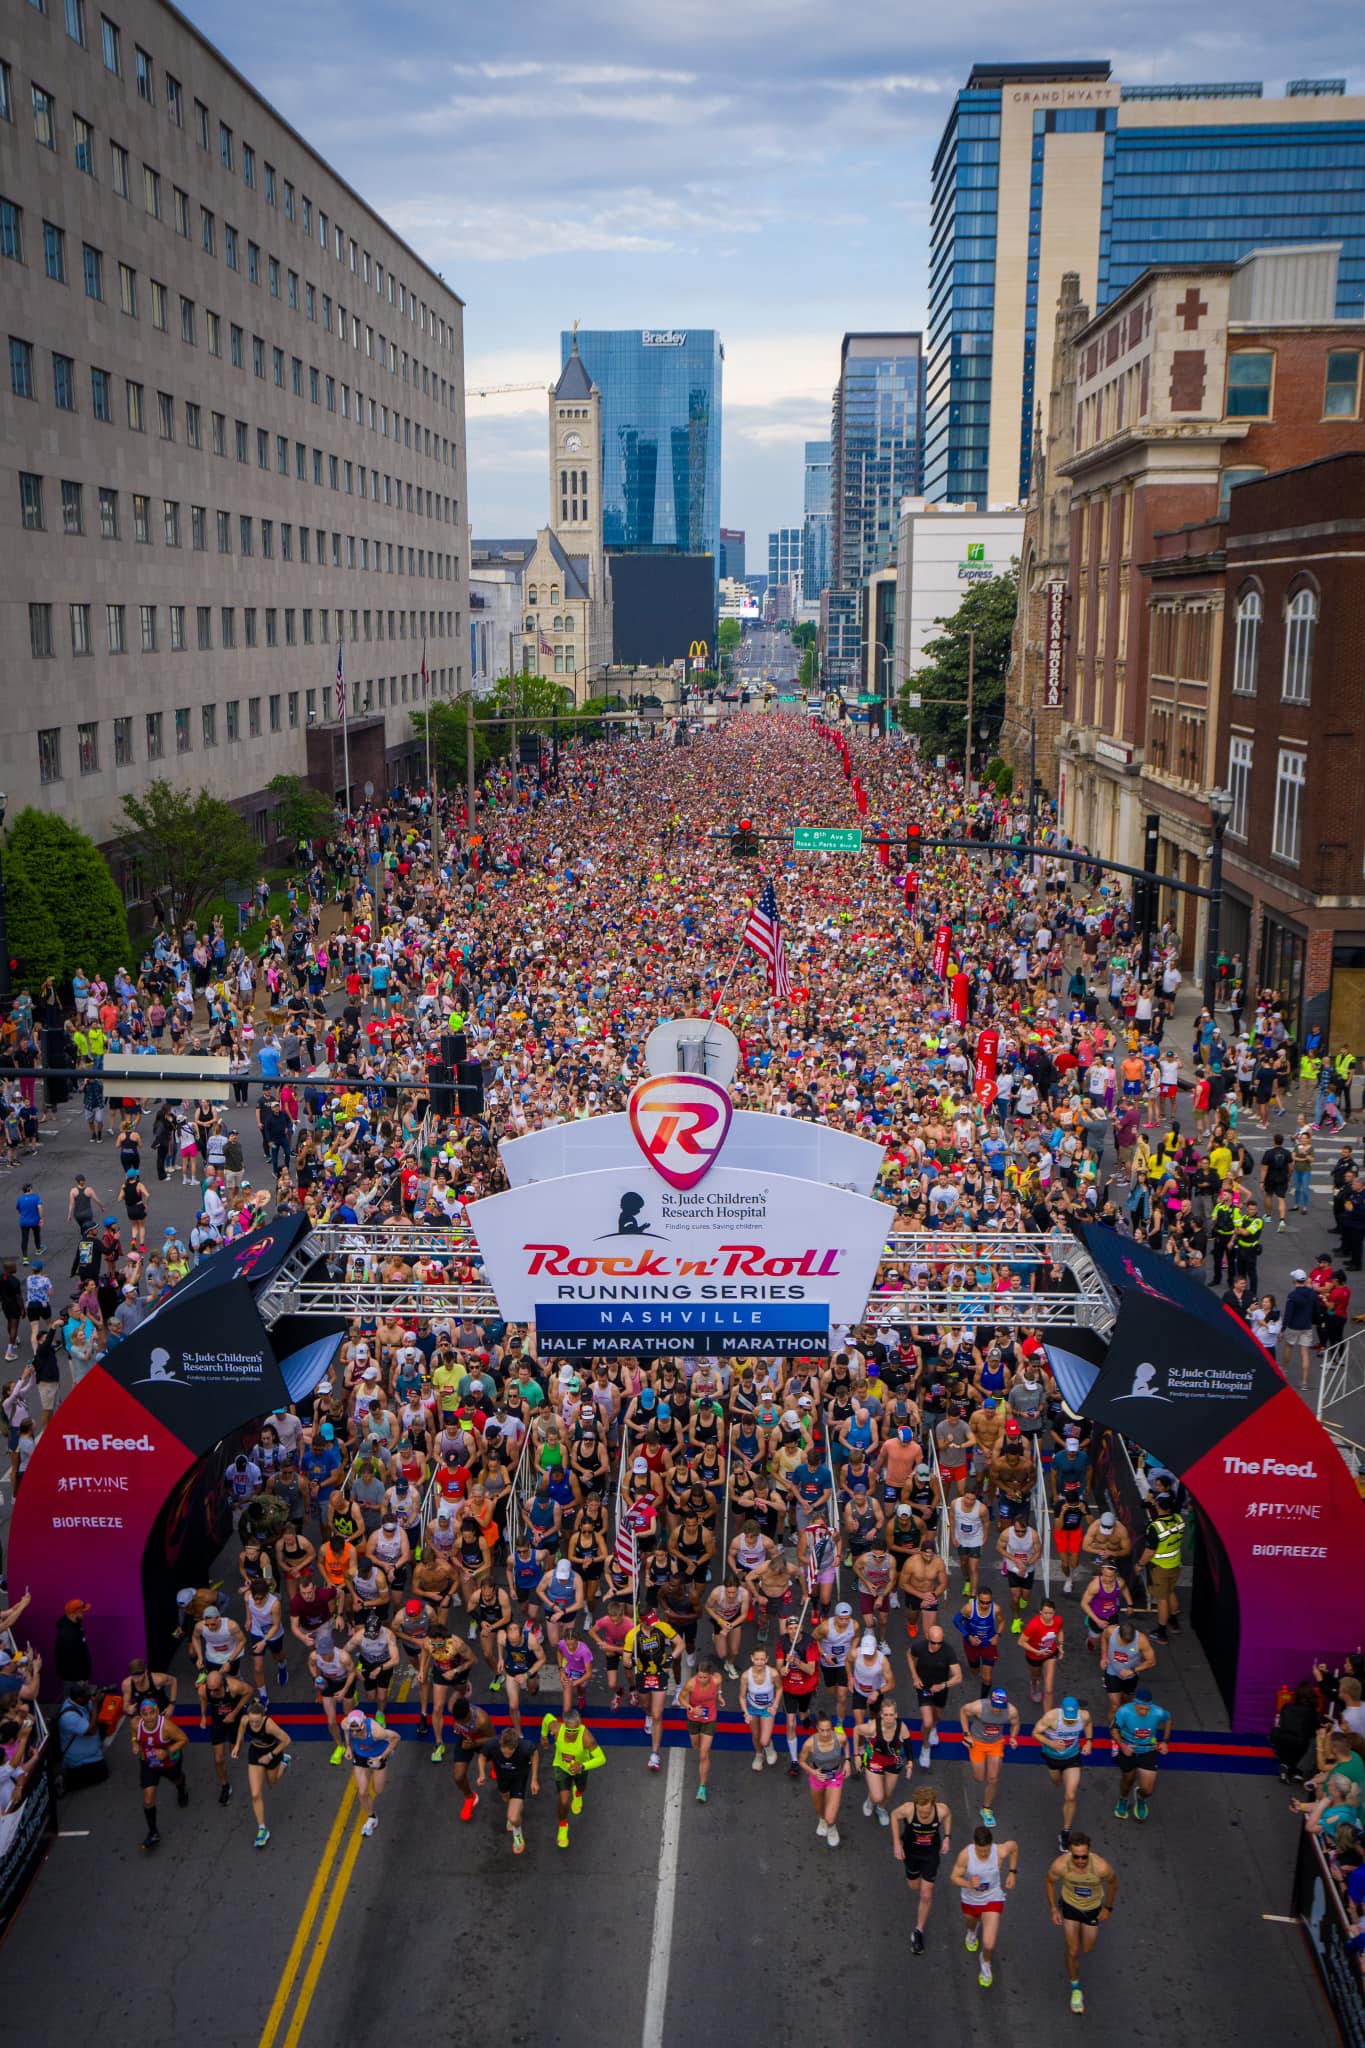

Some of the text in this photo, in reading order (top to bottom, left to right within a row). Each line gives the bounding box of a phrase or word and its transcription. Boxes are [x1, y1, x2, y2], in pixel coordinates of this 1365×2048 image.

[1013, 89, 1112, 102] GRAND HYATT
[642, 330, 687, 346] Bradley
[958, 569, 993, 580] Express
[1048, 583, 1063, 704] MORGAN & MORGAN
[813, 831, 827, 839] 8th
[983, 1044, 992, 1054] 1
[981, 1083, 992, 1096] 2
[662, 1193, 766, 1206] St. Jude Children's
[662, 1207, 766, 1220] Research Hospital
[523, 1244, 672, 1277] Rock
[718, 1245, 840, 1276] Roll
[558, 1285, 805, 1299] RUNNING SERIES
[601, 1311, 762, 1323] NASHVILLE
[541, 1338, 826, 1349] HALF MARATHON MARATHON
[182, 1352, 262, 1363] St. Jude Children's
[183, 1363, 263, 1375] Research Hospital
[1168, 1368, 1253, 1380] St. Jude Children's
[1168, 1378, 1252, 1392] Research Hospital
[62, 1433, 155, 1451] The Feed.
[1223, 1456, 1318, 1478] The Feed.
[68, 1477, 129, 1491] FITVINE
[1258, 1503, 1321, 1519] FITVINE
